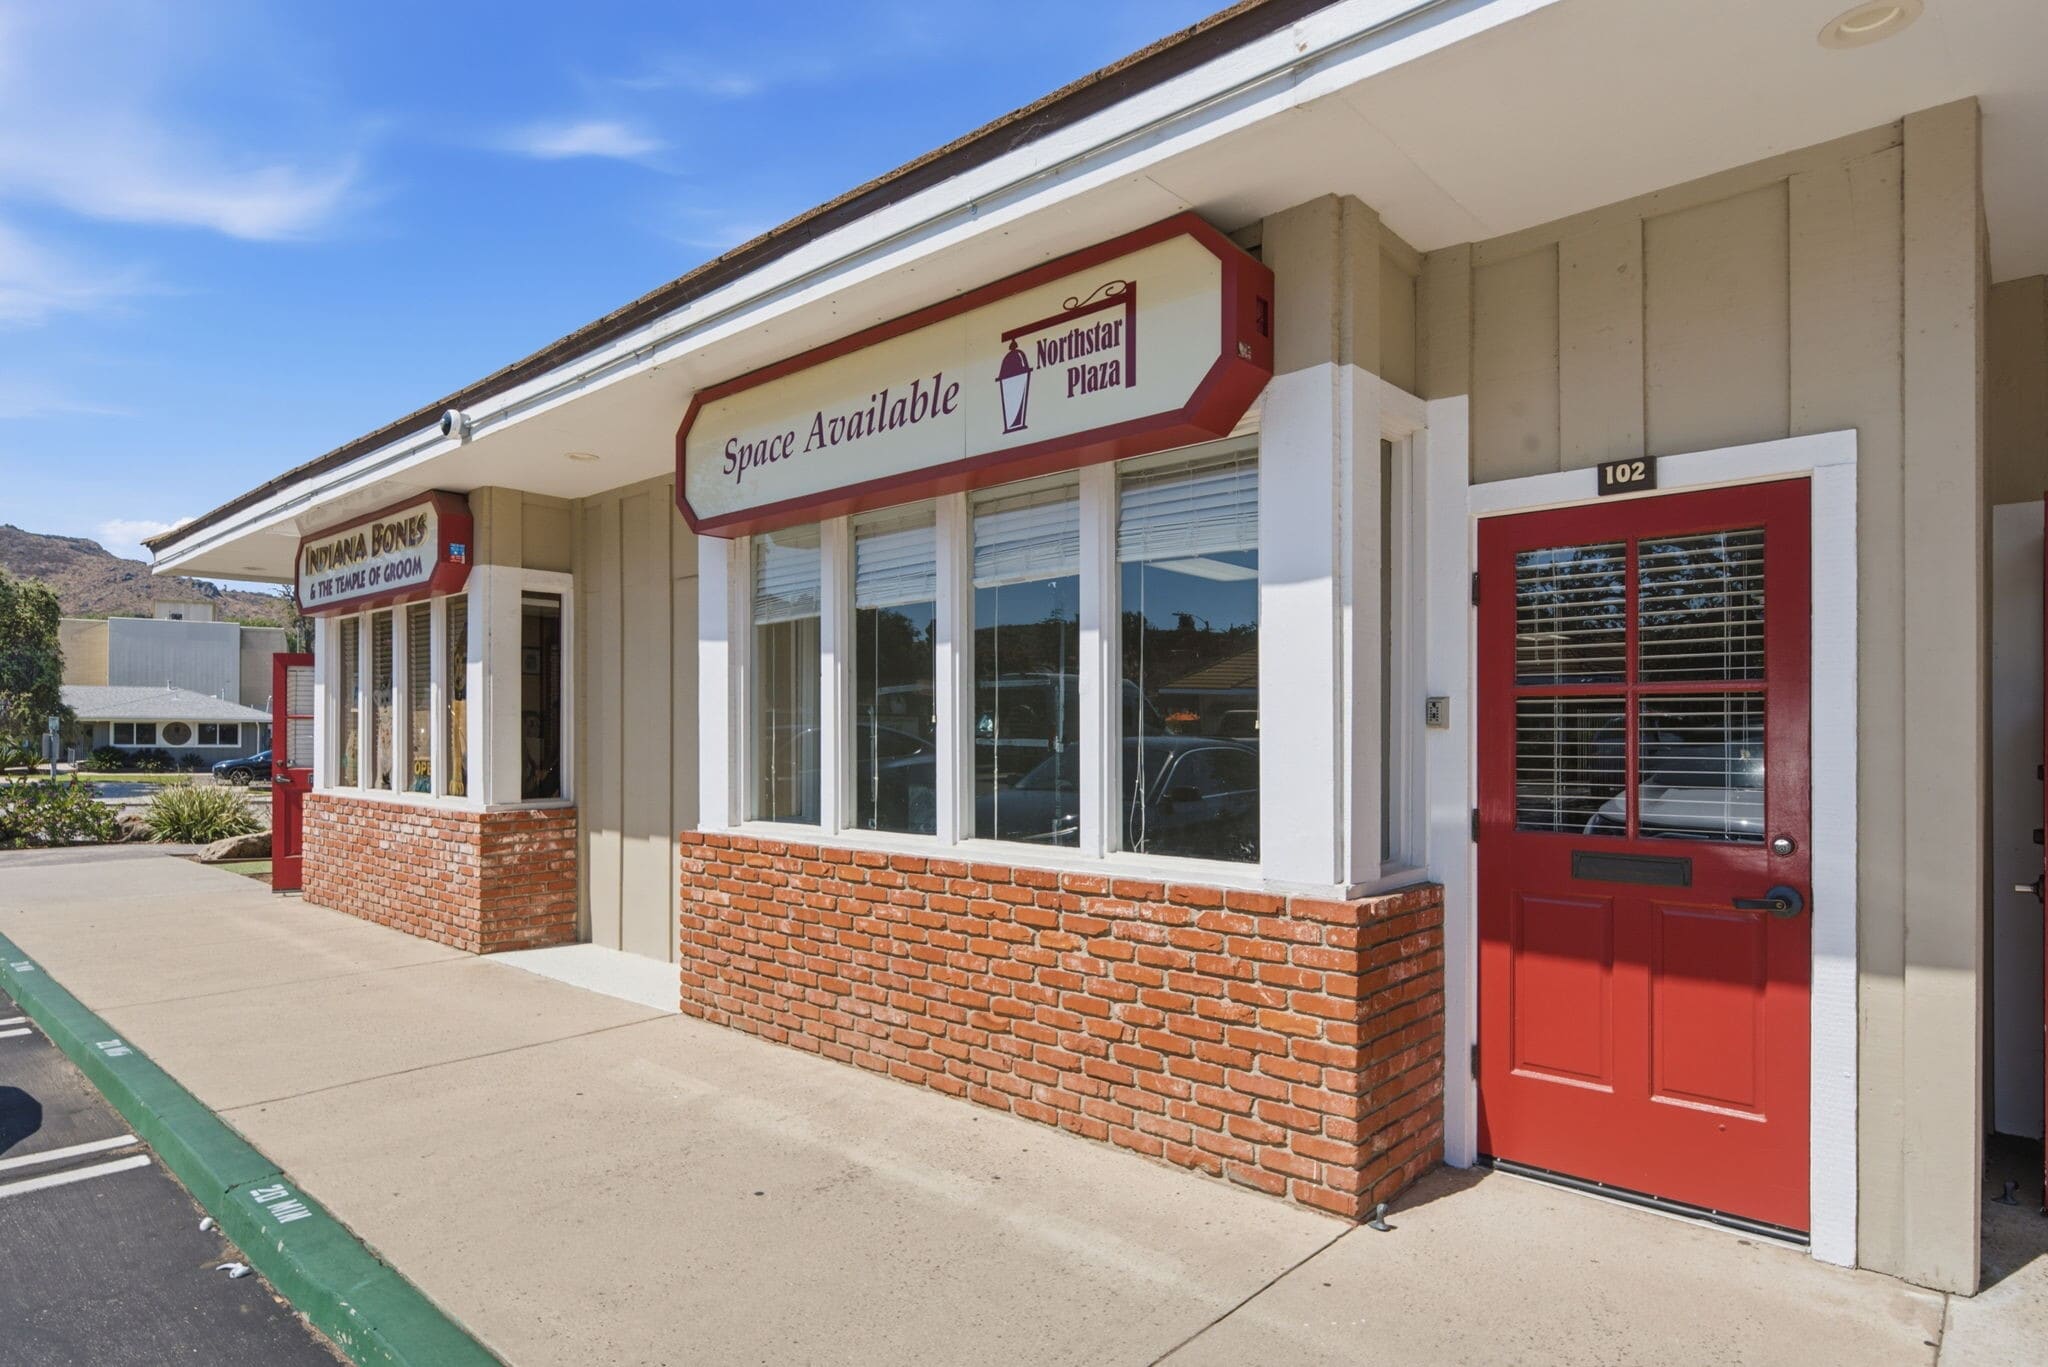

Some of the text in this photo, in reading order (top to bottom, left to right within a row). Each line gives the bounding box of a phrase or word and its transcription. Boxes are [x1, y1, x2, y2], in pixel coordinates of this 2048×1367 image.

[1036, 318, 1123, 370] Northstar
[1067, 359, 1120, 398] Plaza
[723, 372, 960, 484] Space Available
[1605, 461, 1646, 485] 102
[304, 512, 429, 577] INDIANA BONES
[310, 555, 423, 600] & THE TEMPLE OF GROOM
[414, 760, 431, 776] OPE
[249, 1183, 313, 1224] 20 MIN
